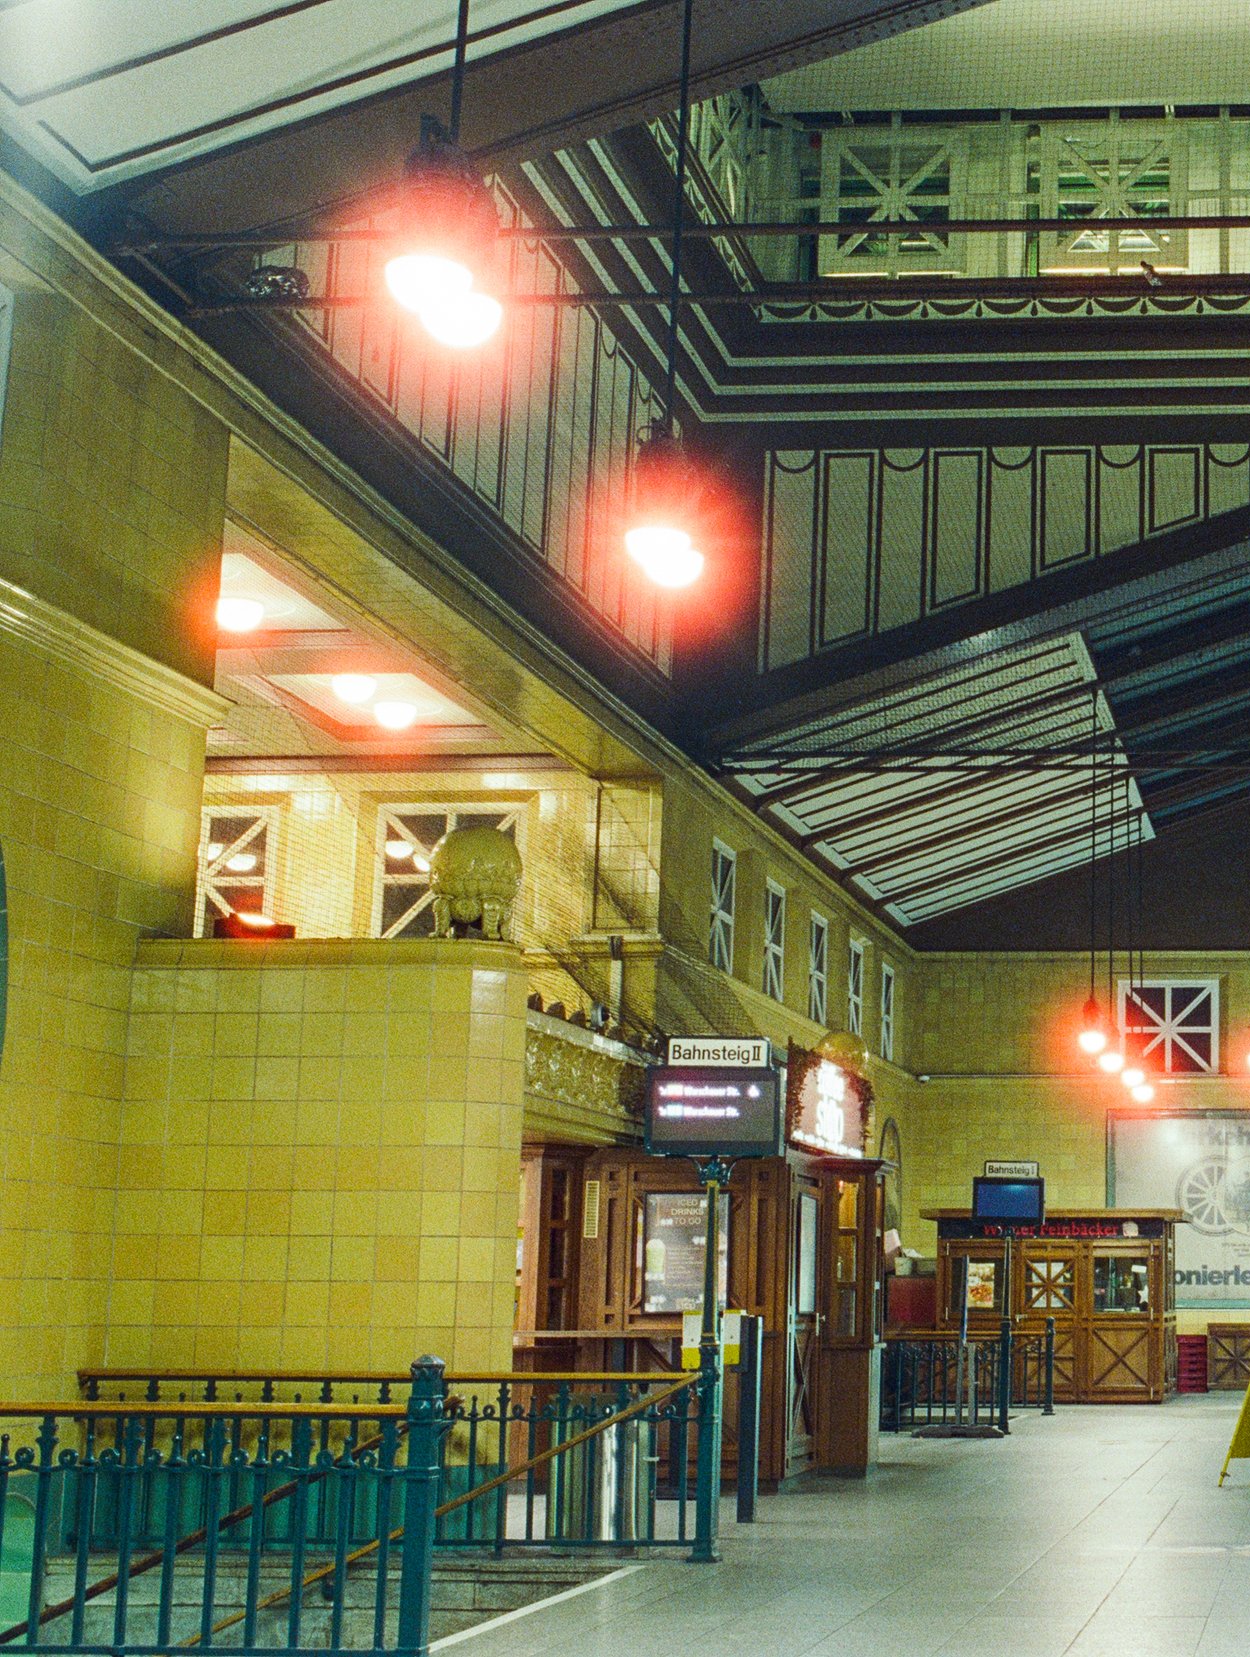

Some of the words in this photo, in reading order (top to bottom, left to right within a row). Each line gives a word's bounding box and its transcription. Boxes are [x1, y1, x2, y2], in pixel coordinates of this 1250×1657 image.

[672, 1044, 751, 1064] Bahnsteig
[988, 1164, 1030, 1176] Bahnsteig
[983, 1225, 1035, 1237] Wner
